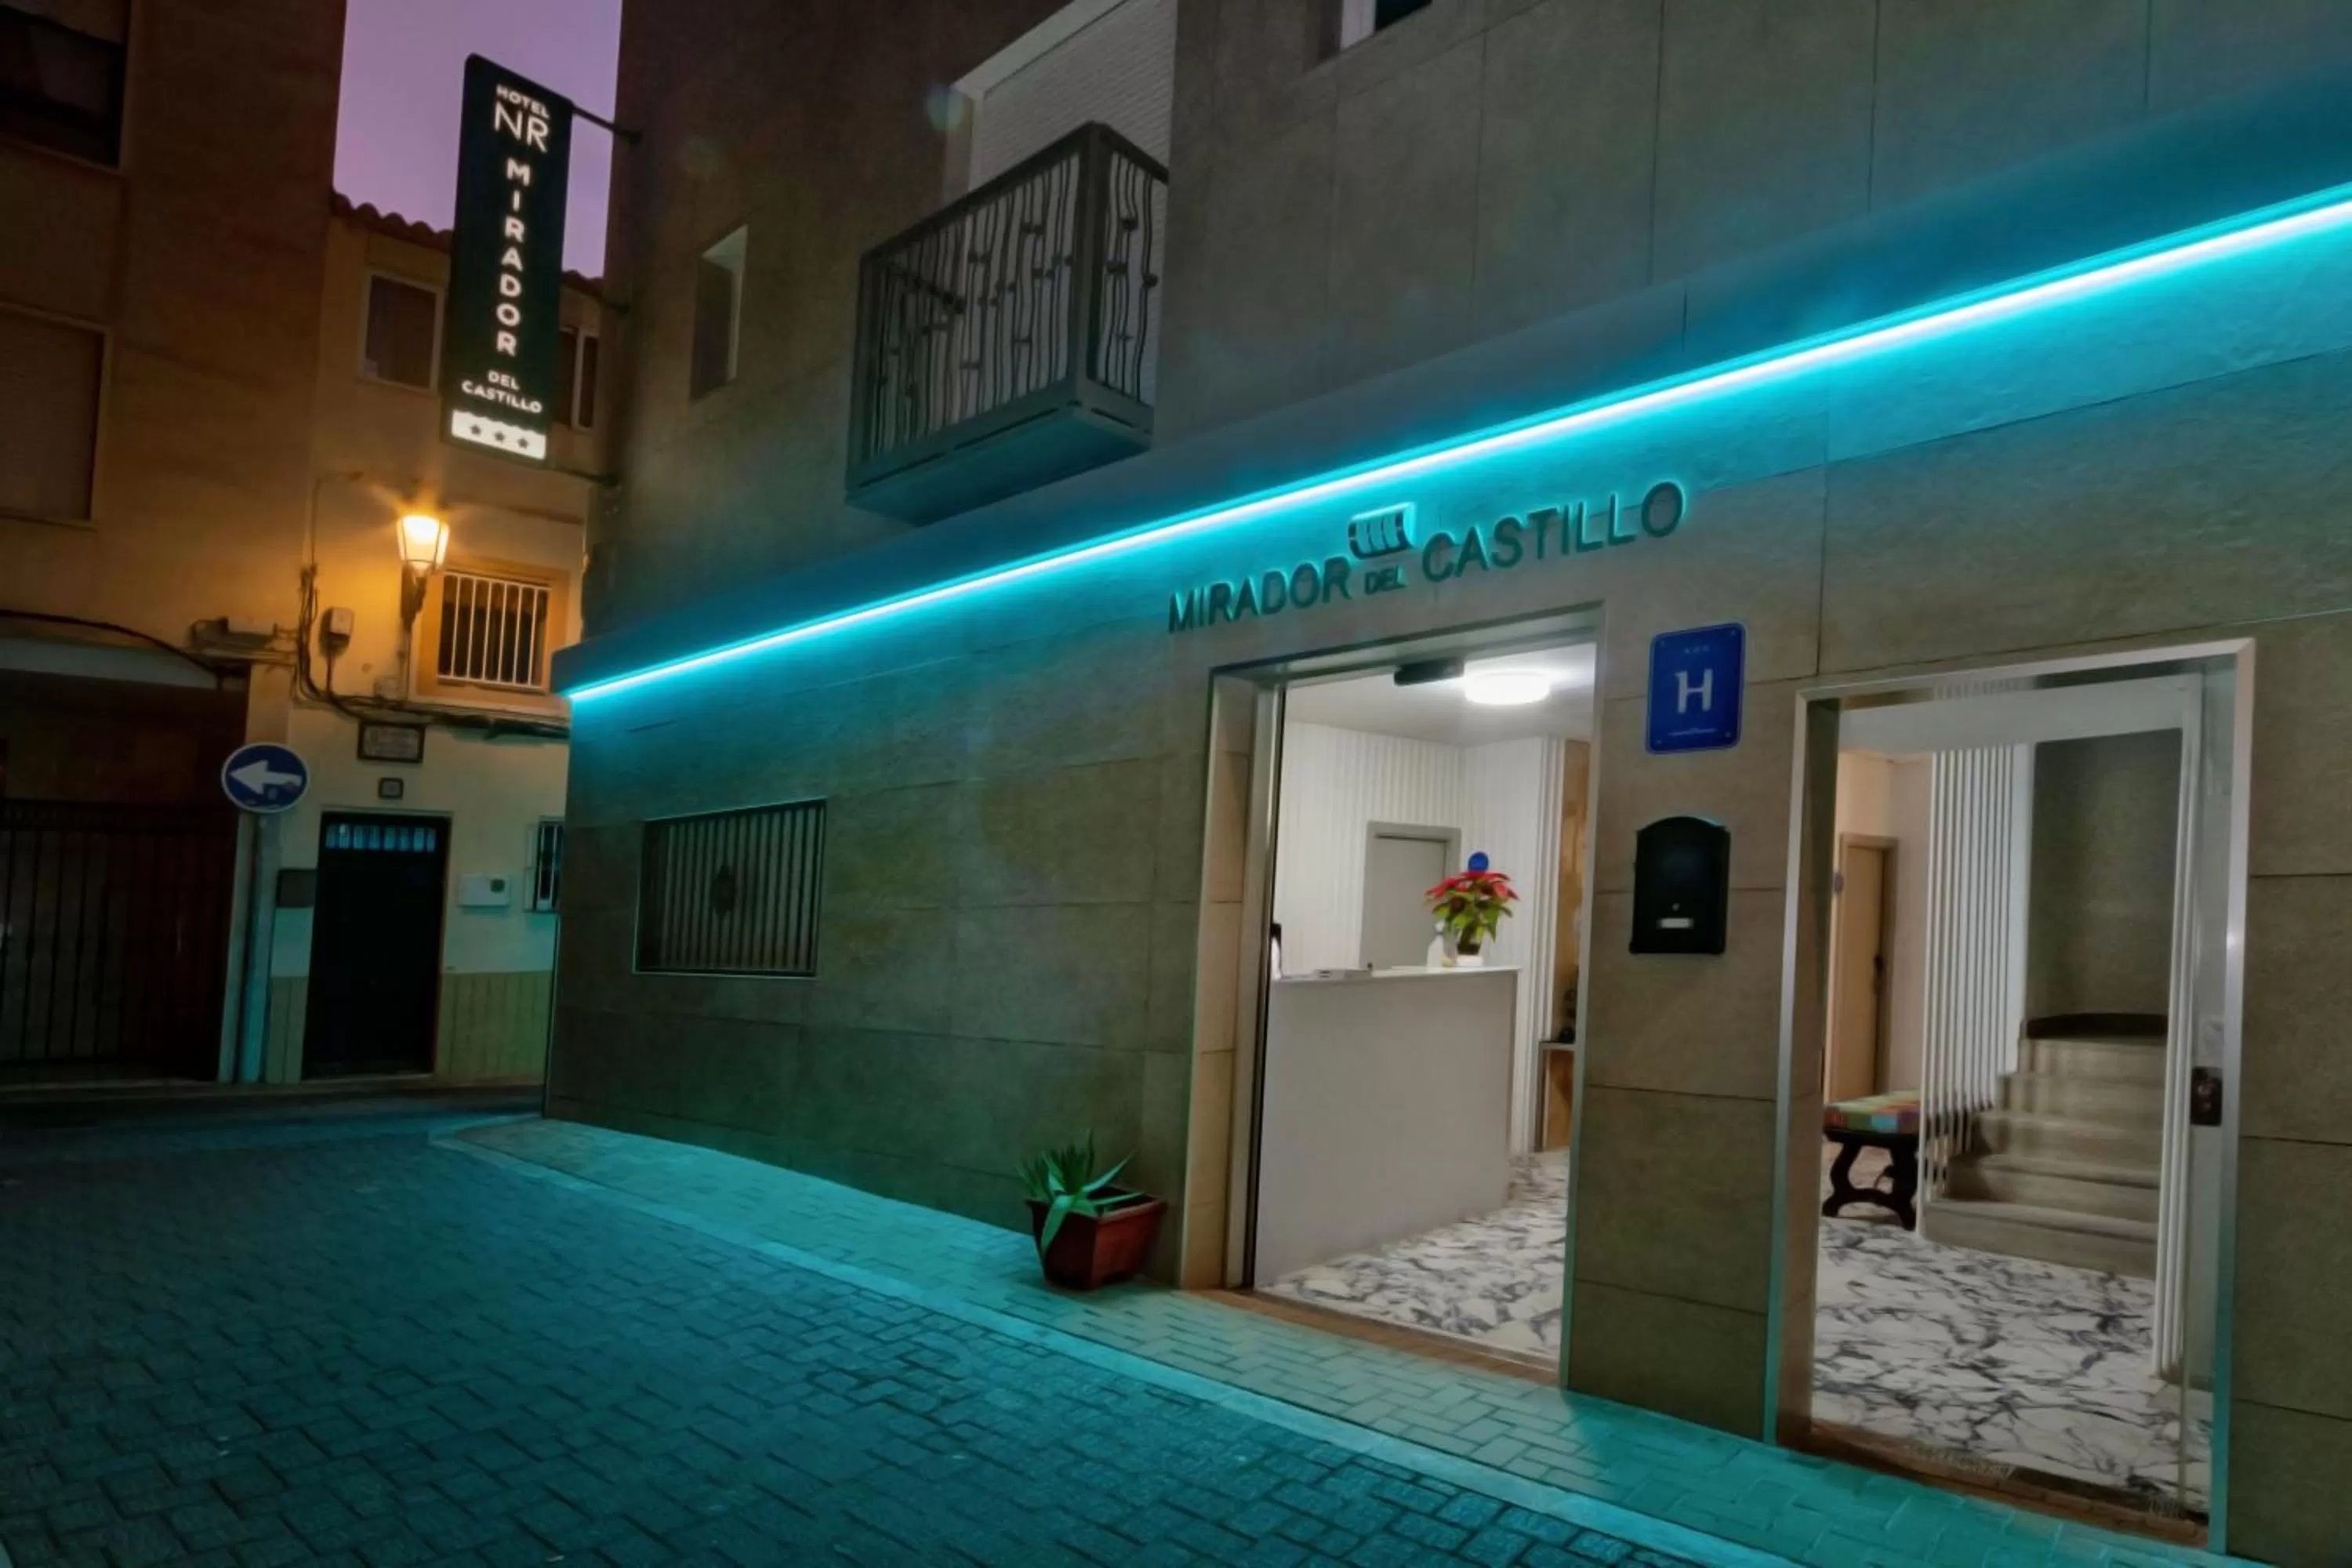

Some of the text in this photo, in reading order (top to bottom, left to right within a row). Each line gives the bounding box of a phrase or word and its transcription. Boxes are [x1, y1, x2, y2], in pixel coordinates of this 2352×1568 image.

[496, 84, 550, 118] HOTEL
[495, 102, 549, 153] NR
[496, 158, 530, 358] MIRADOR
[462, 380, 542, 414] CASTILLO
[488, 370, 520, 390] DEL
[1168, 481, 1684, 633] MIRADOR DEL CASTILLO
[1675, 669, 1713, 714] H
